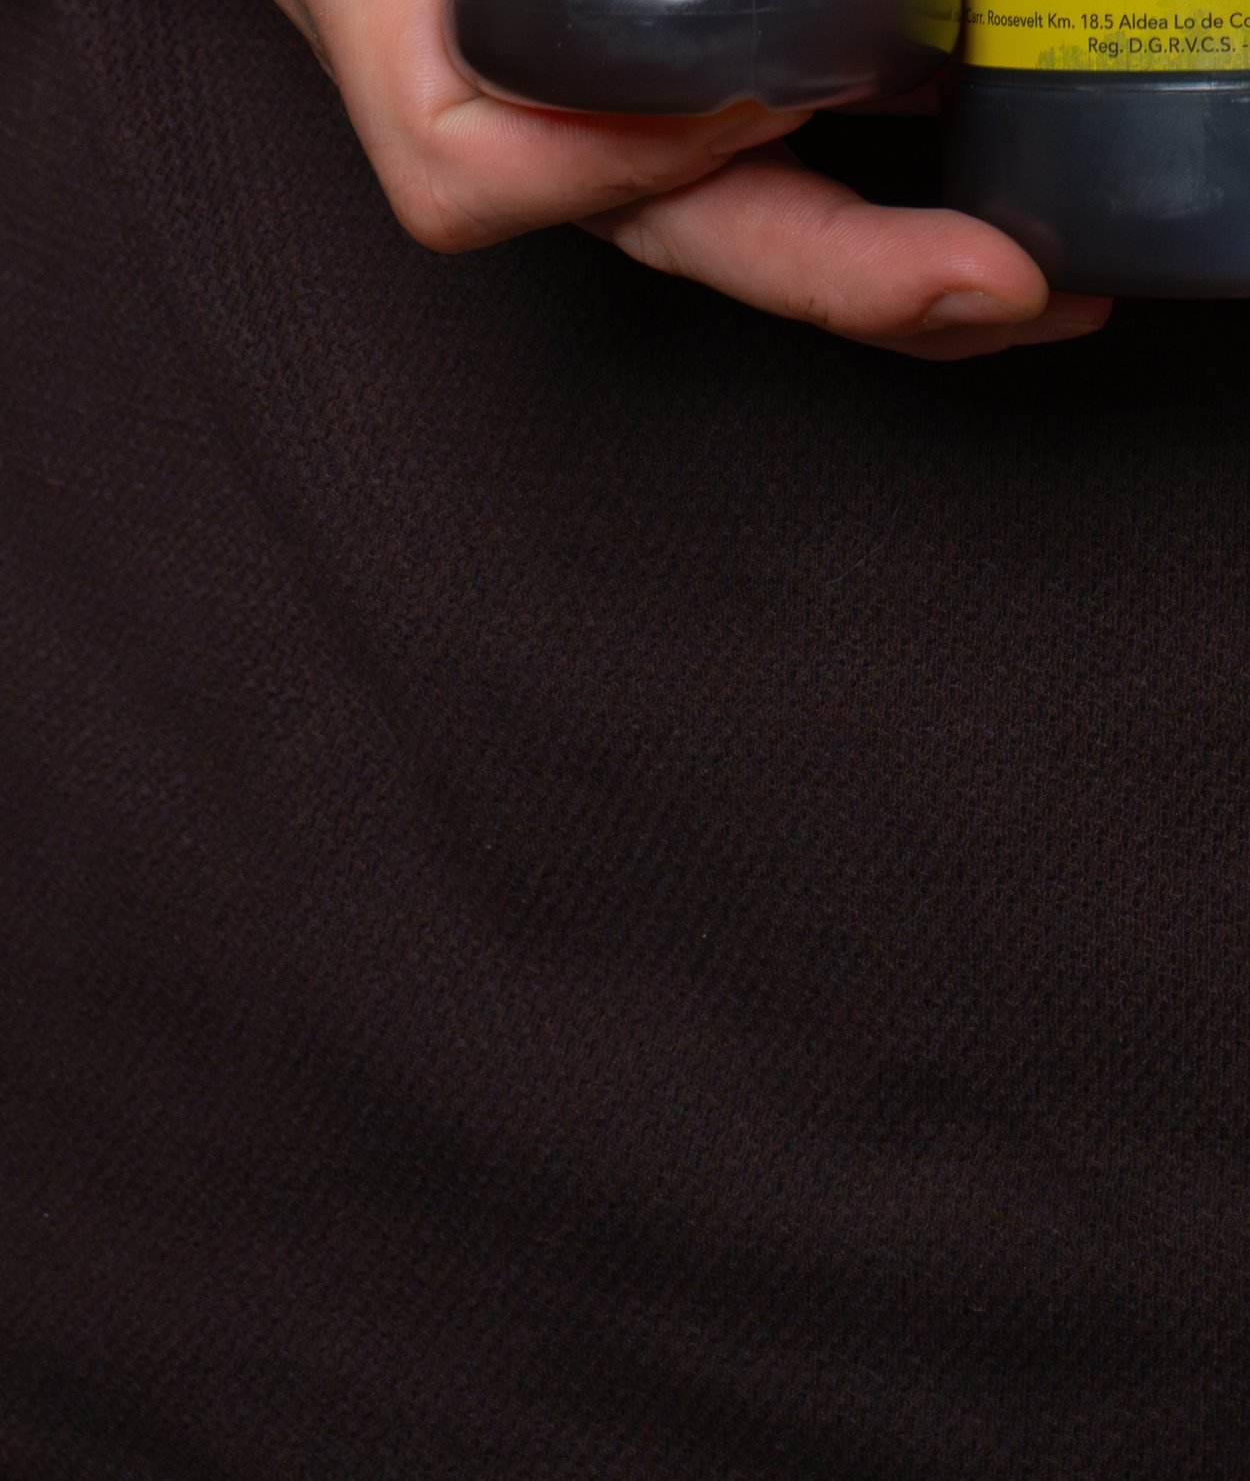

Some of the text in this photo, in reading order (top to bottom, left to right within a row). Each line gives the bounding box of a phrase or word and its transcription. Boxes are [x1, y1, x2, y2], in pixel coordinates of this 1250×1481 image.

[987, 9, 1043, 29] Roosevelt
[1049, 12, 1075, 29] Km.
[1081, 13, 1114, 30] 18.5
[1119, 13, 1168, 30] Aldea
[1175, 13, 1196, 30] Lo
[1201, 12, 1223, 30] de
[1088, 37, 1123, 57] Reg.
[1129, 35, 1236, 53] D.G.R.V.C.S.
